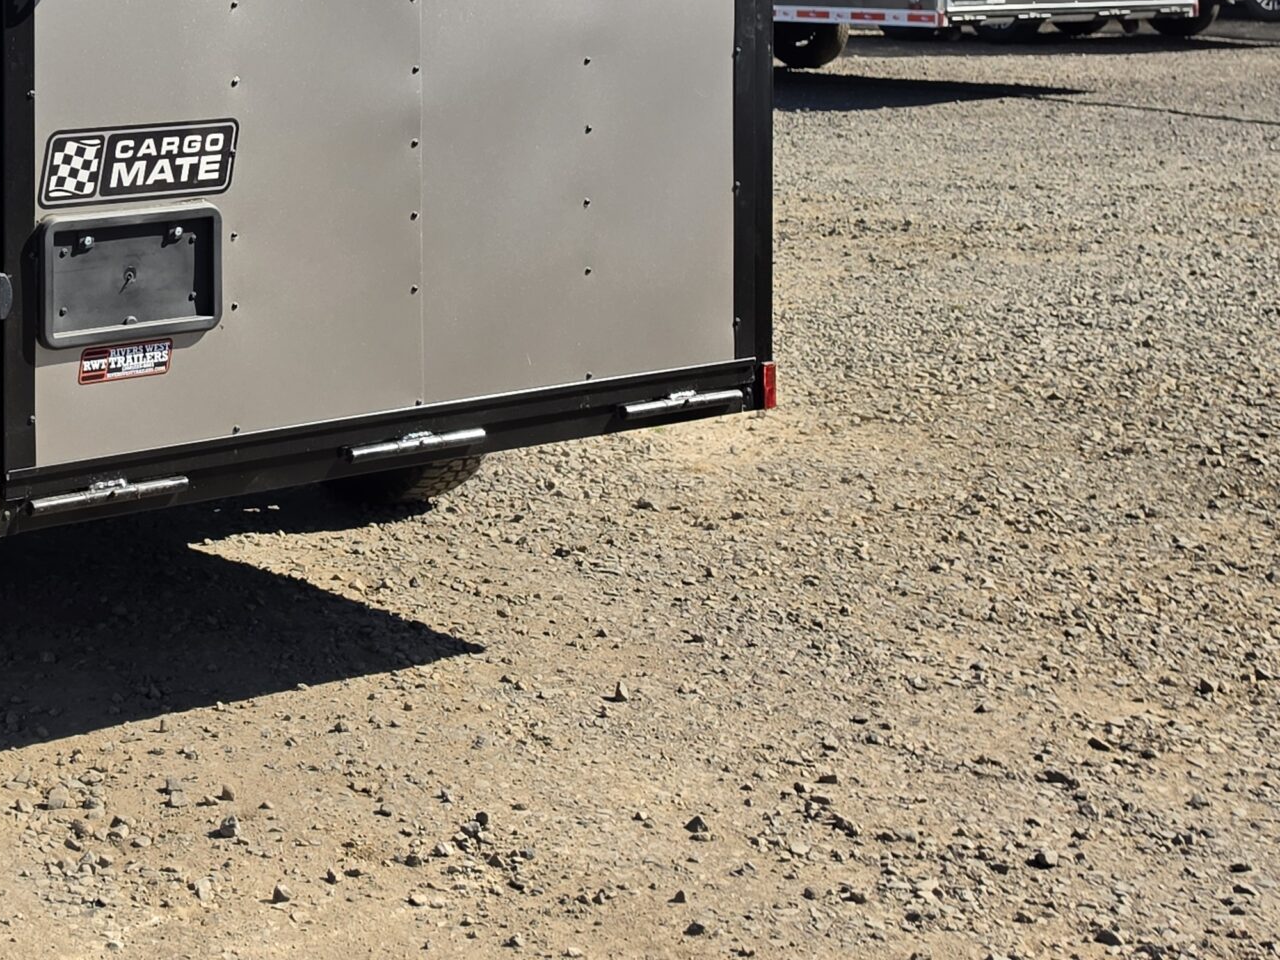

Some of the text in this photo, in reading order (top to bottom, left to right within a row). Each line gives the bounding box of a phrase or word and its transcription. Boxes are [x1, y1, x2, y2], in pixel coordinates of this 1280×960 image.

[115, 133, 225, 159] CARGO
[109, 154, 222, 188] MATE
[110, 342, 170, 357] RIVERS WEST
[83, 358, 108, 372] RWT
[108, 350, 169, 369] TRAILERS
